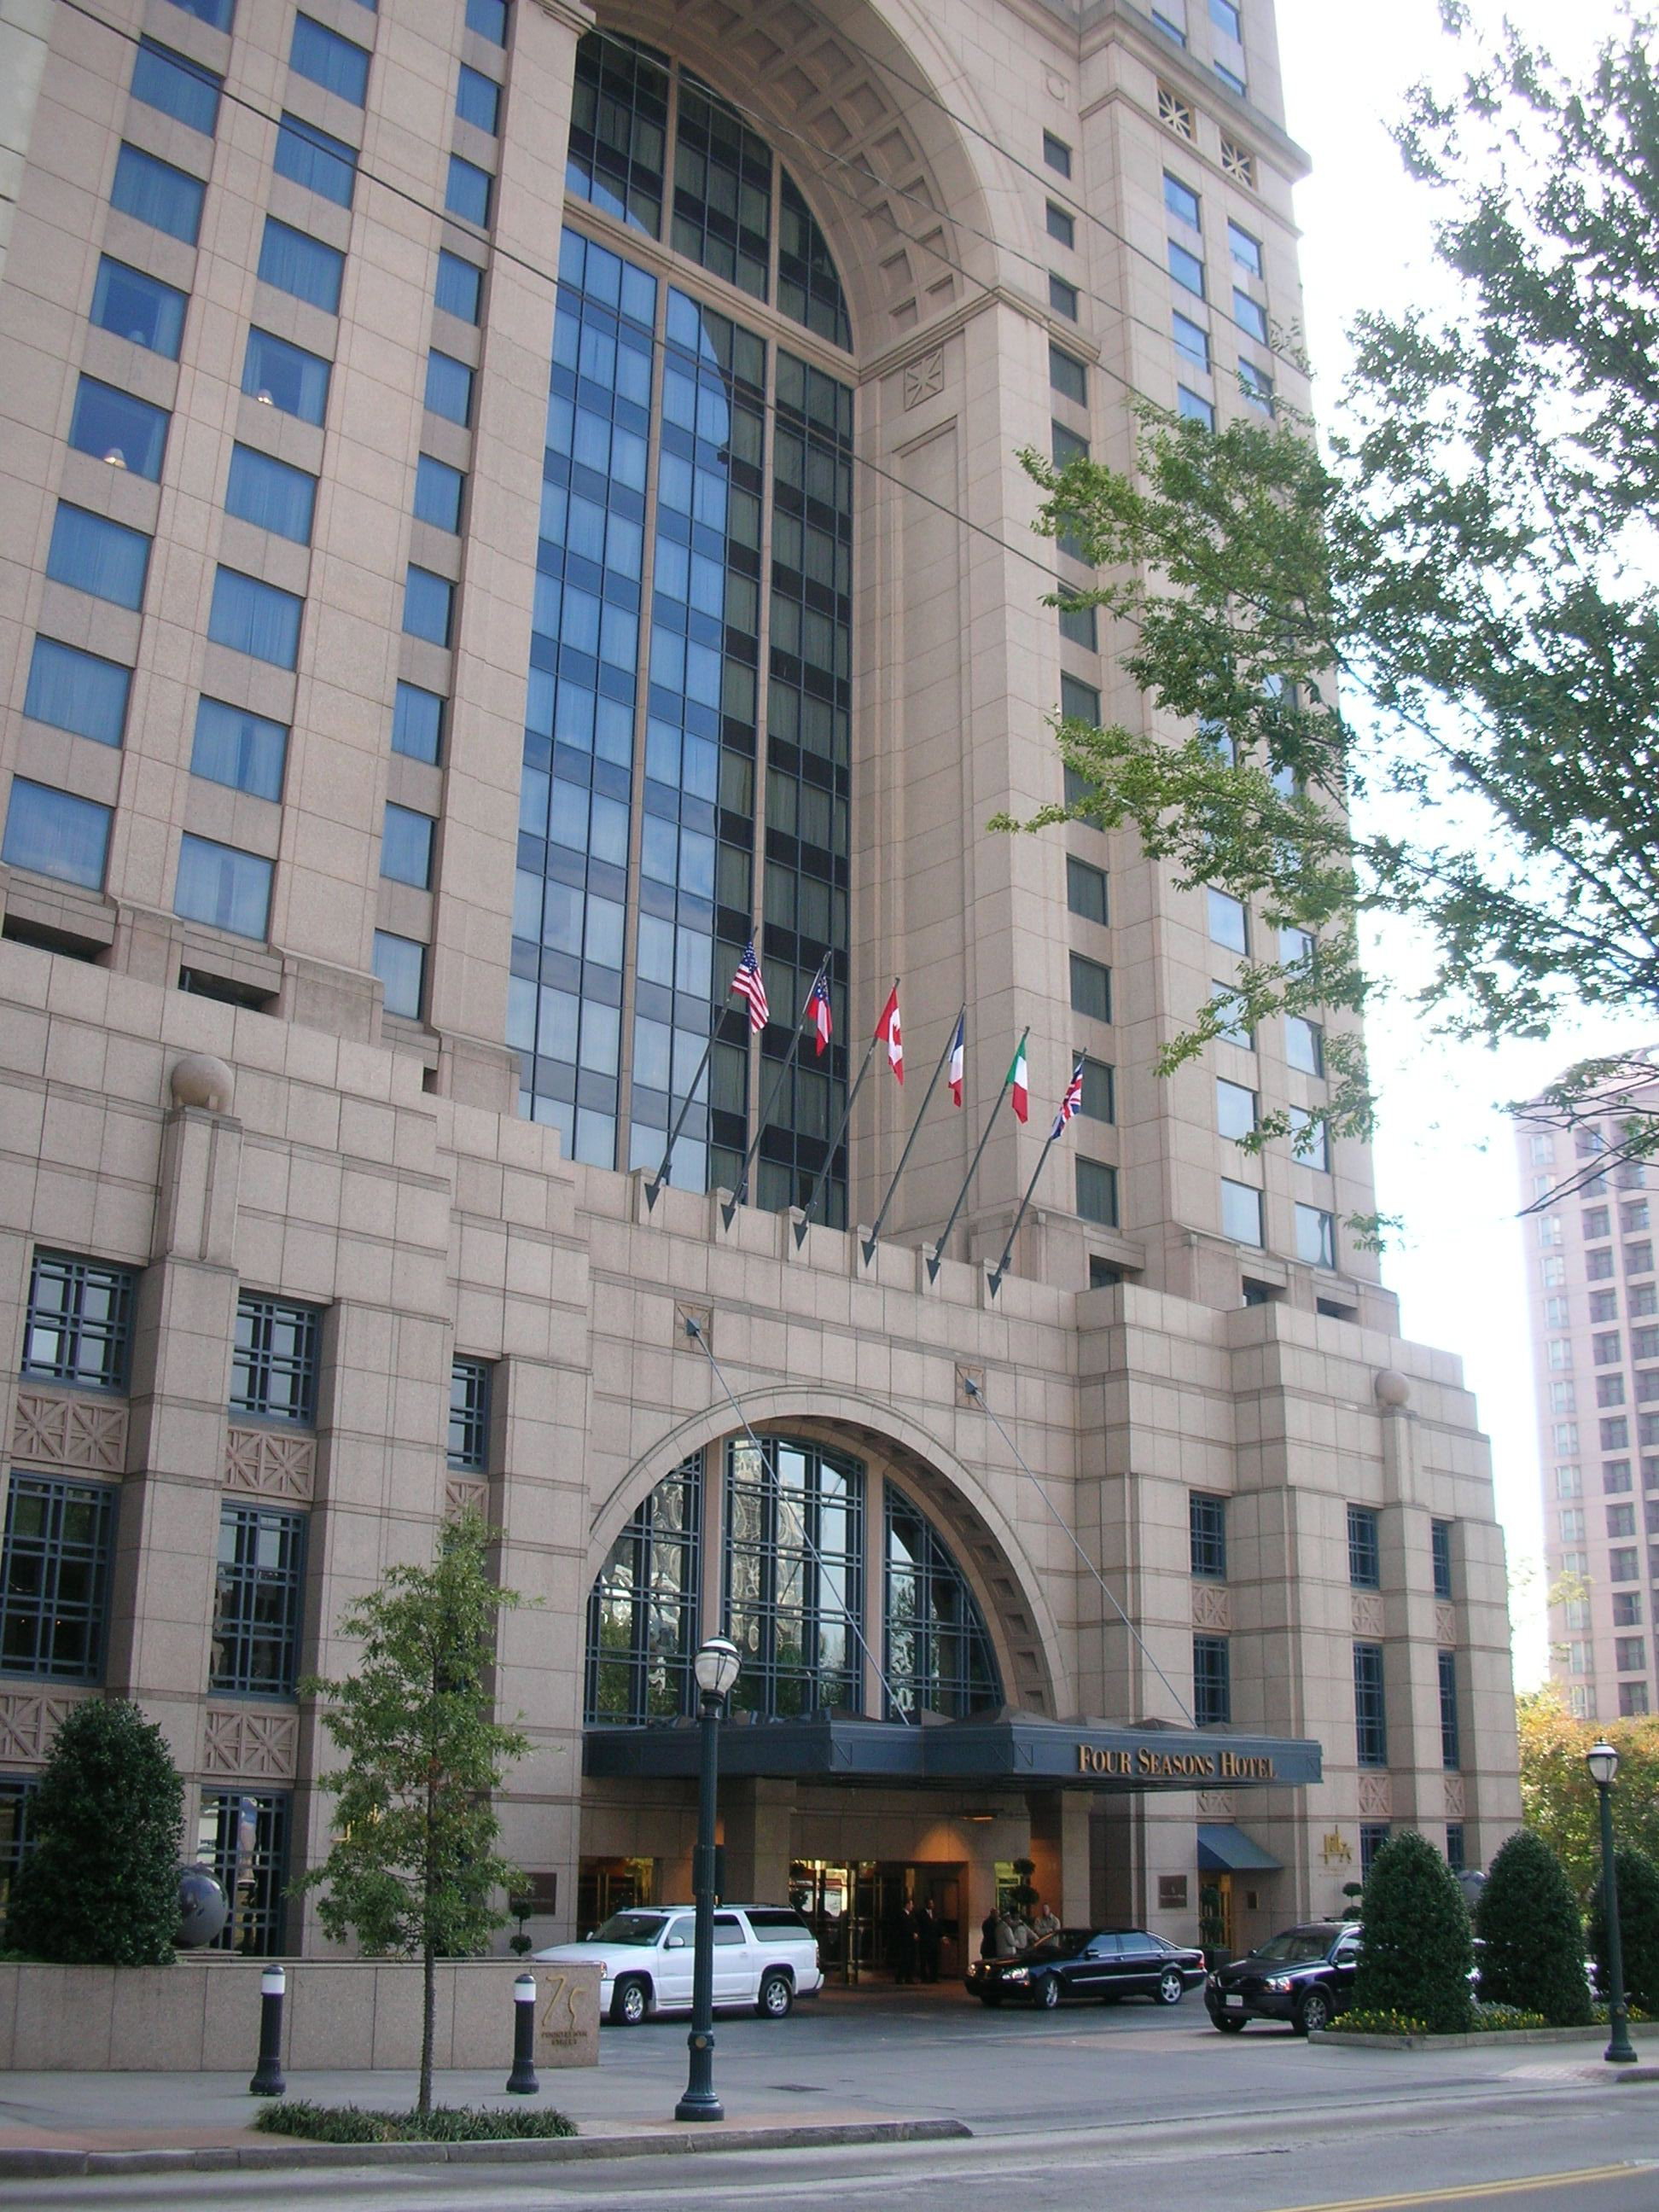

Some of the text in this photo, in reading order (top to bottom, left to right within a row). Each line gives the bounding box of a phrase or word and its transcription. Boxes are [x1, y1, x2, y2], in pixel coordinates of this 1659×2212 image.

[1079, 1744, 1278, 1779] FOUR SEASONS HOTEL
[542, 1975, 587, 2029] 75
